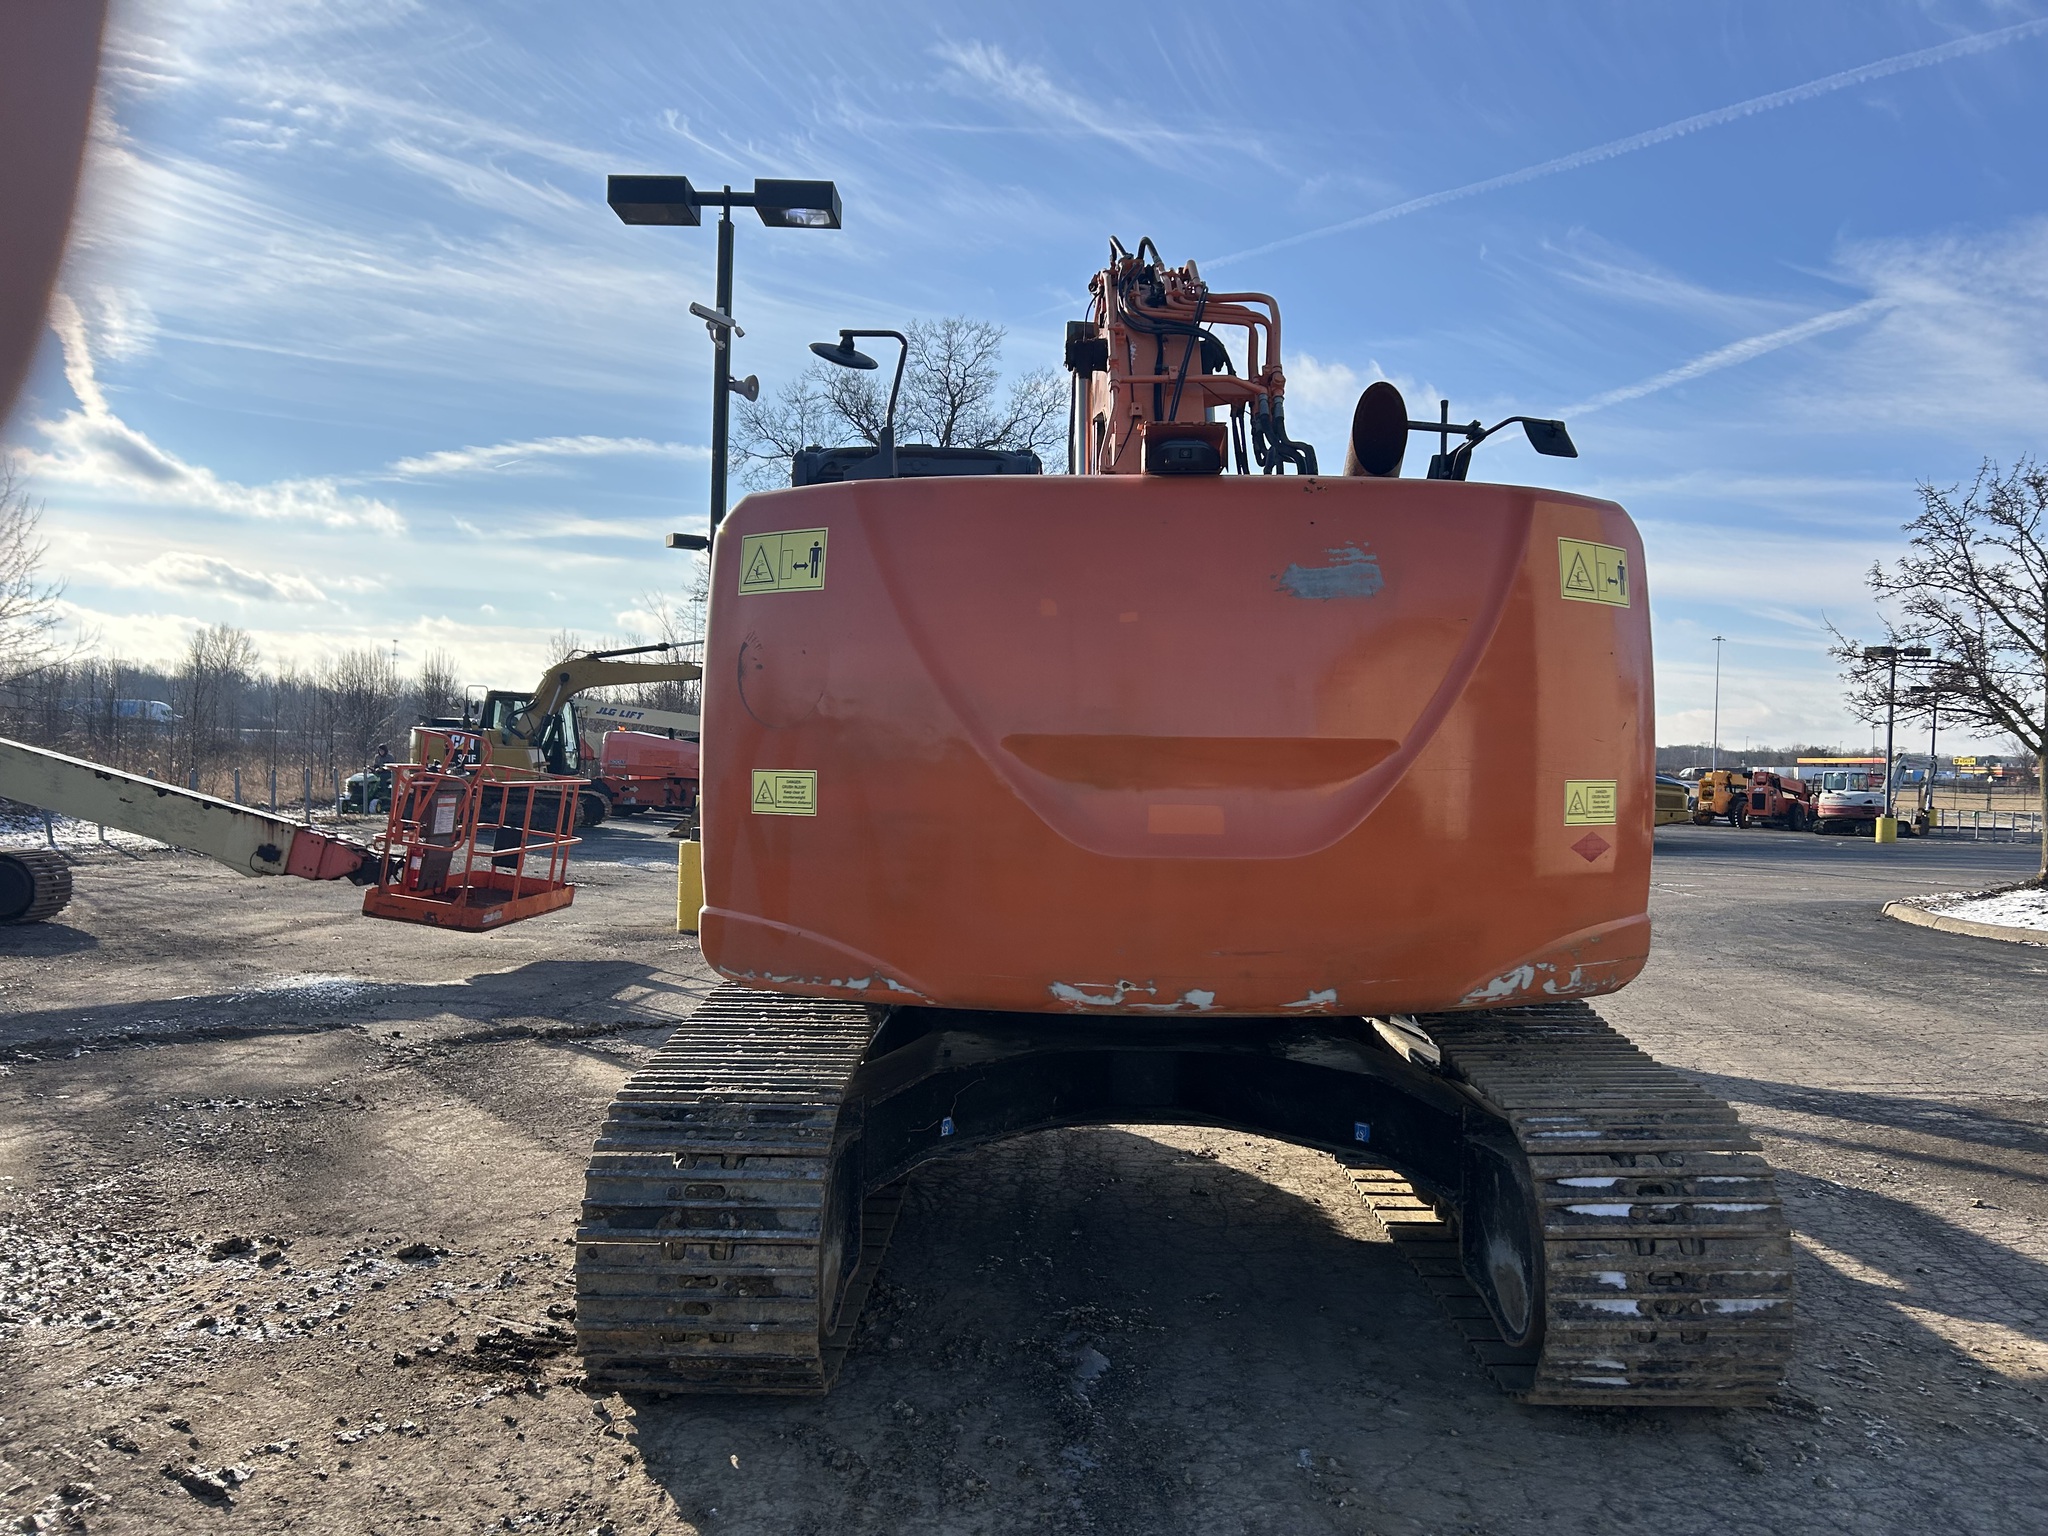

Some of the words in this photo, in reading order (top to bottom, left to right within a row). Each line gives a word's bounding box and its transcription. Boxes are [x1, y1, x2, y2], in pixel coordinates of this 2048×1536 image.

[596, 707, 617, 716] JLG
[619, 710, 645, 720] LIFT
[457, 754, 476, 763] 31F
